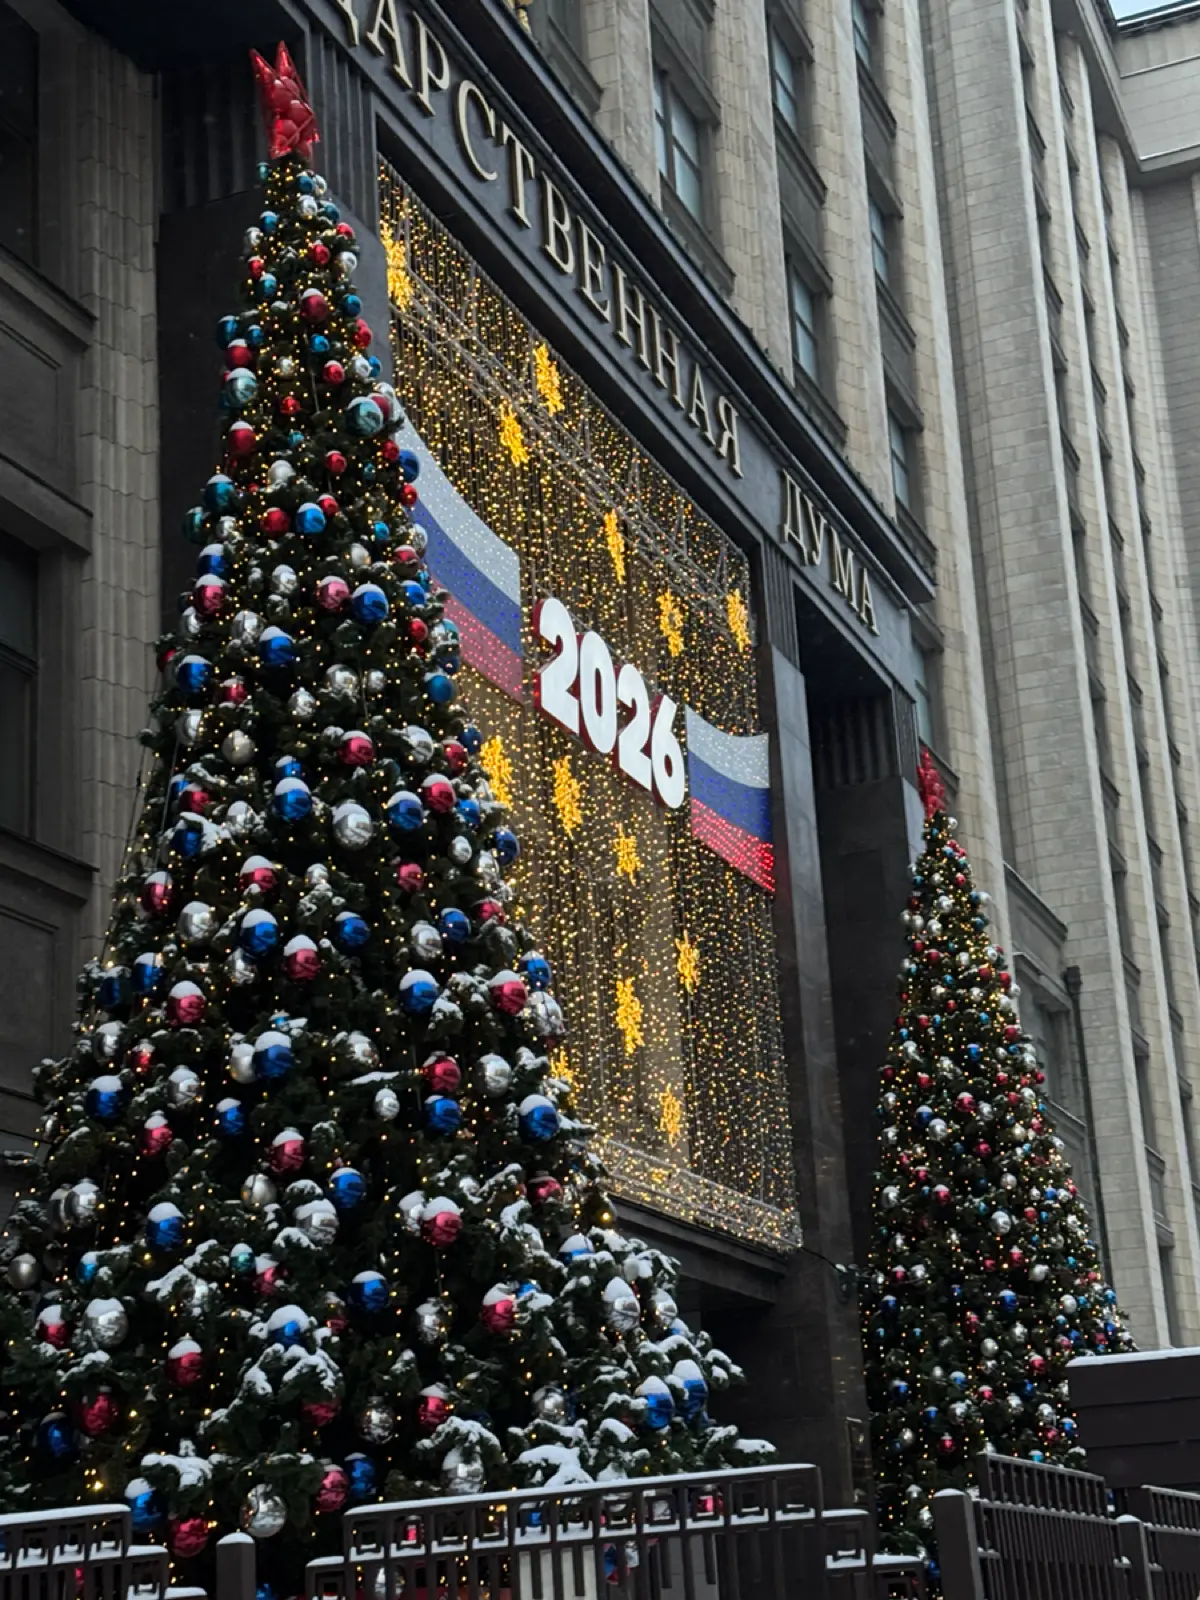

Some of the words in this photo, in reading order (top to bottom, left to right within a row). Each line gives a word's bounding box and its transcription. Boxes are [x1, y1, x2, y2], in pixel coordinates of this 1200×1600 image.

[336, 0, 744, 478] АРСТВЕННАЯ
[782, 468, 880, 636] ДУМА
[536, 597, 686, 809] 2026
